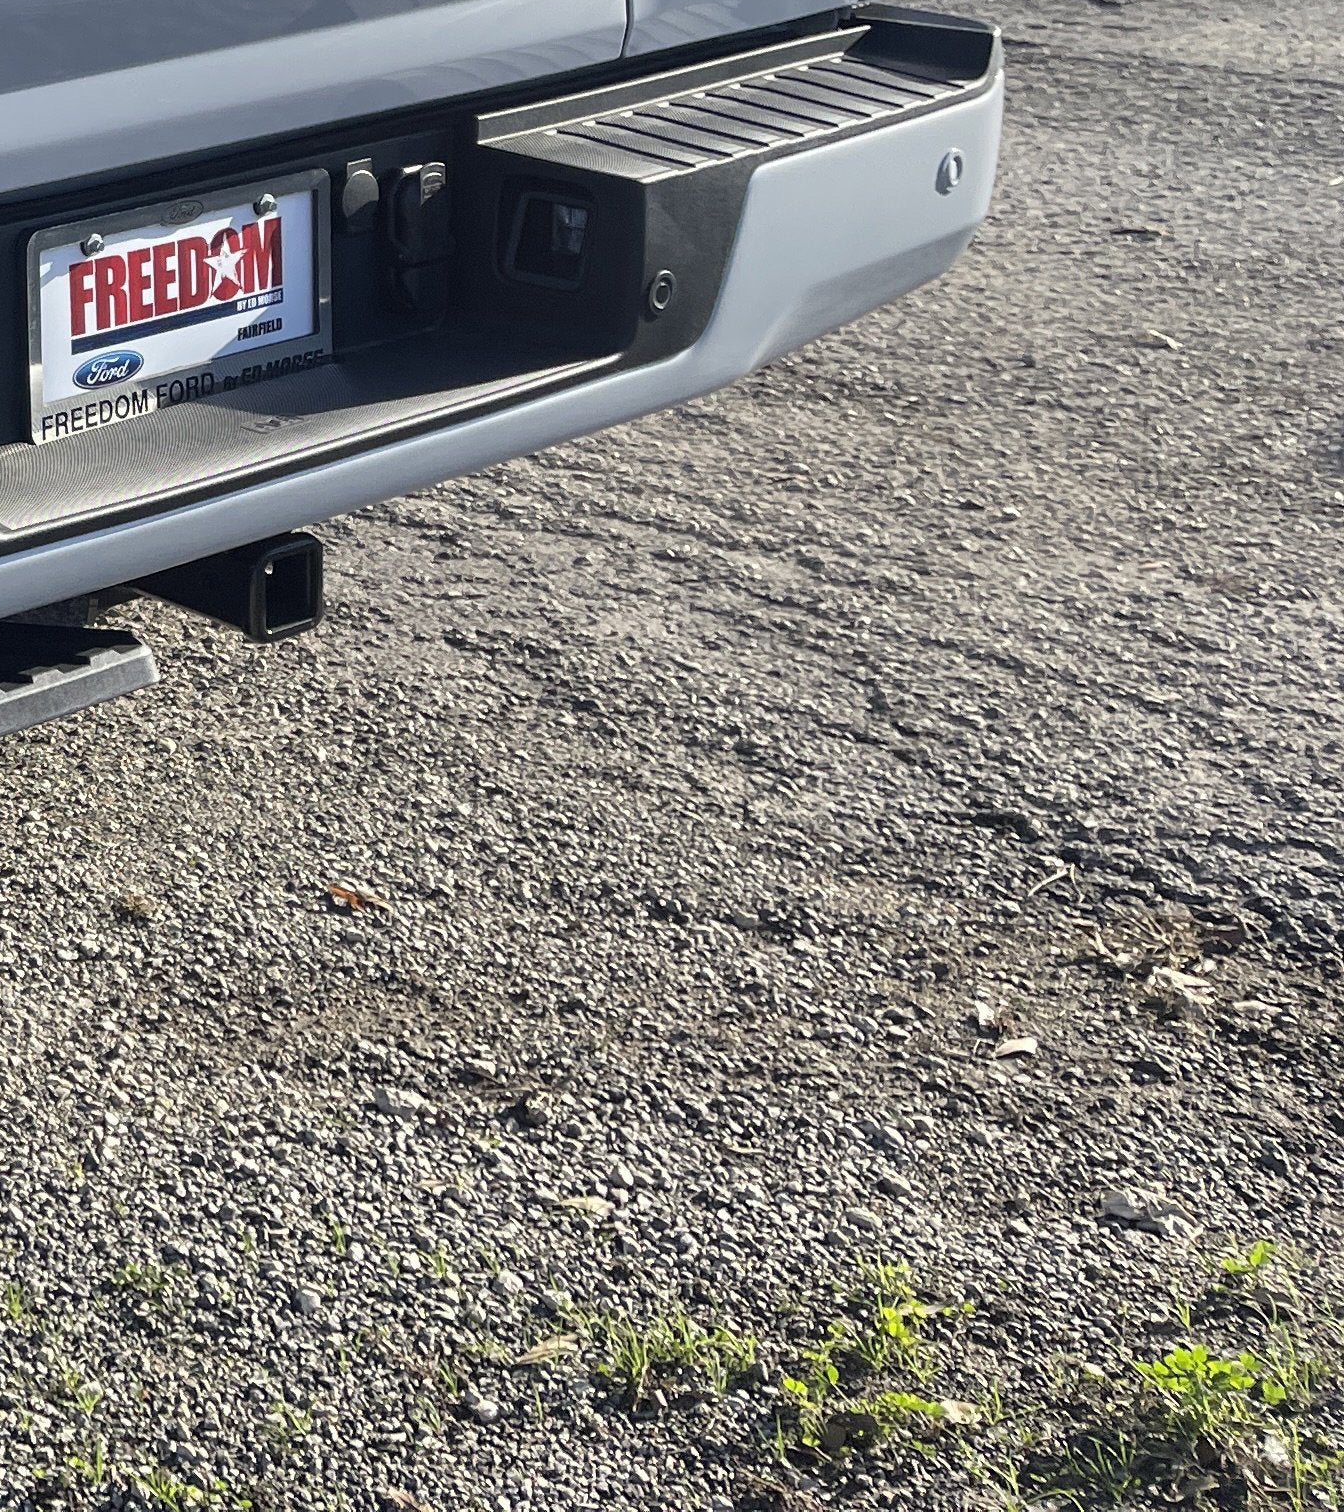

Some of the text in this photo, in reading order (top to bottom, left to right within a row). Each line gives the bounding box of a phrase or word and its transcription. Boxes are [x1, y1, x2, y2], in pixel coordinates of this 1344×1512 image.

[68, 216, 284, 337] FREEDOM
[237, 317, 283, 341] FAIRFIELD
[88, 358, 130, 385] Ford
[41, 389, 149, 441] FREEDOM
[156, 372, 215, 409] FORD
